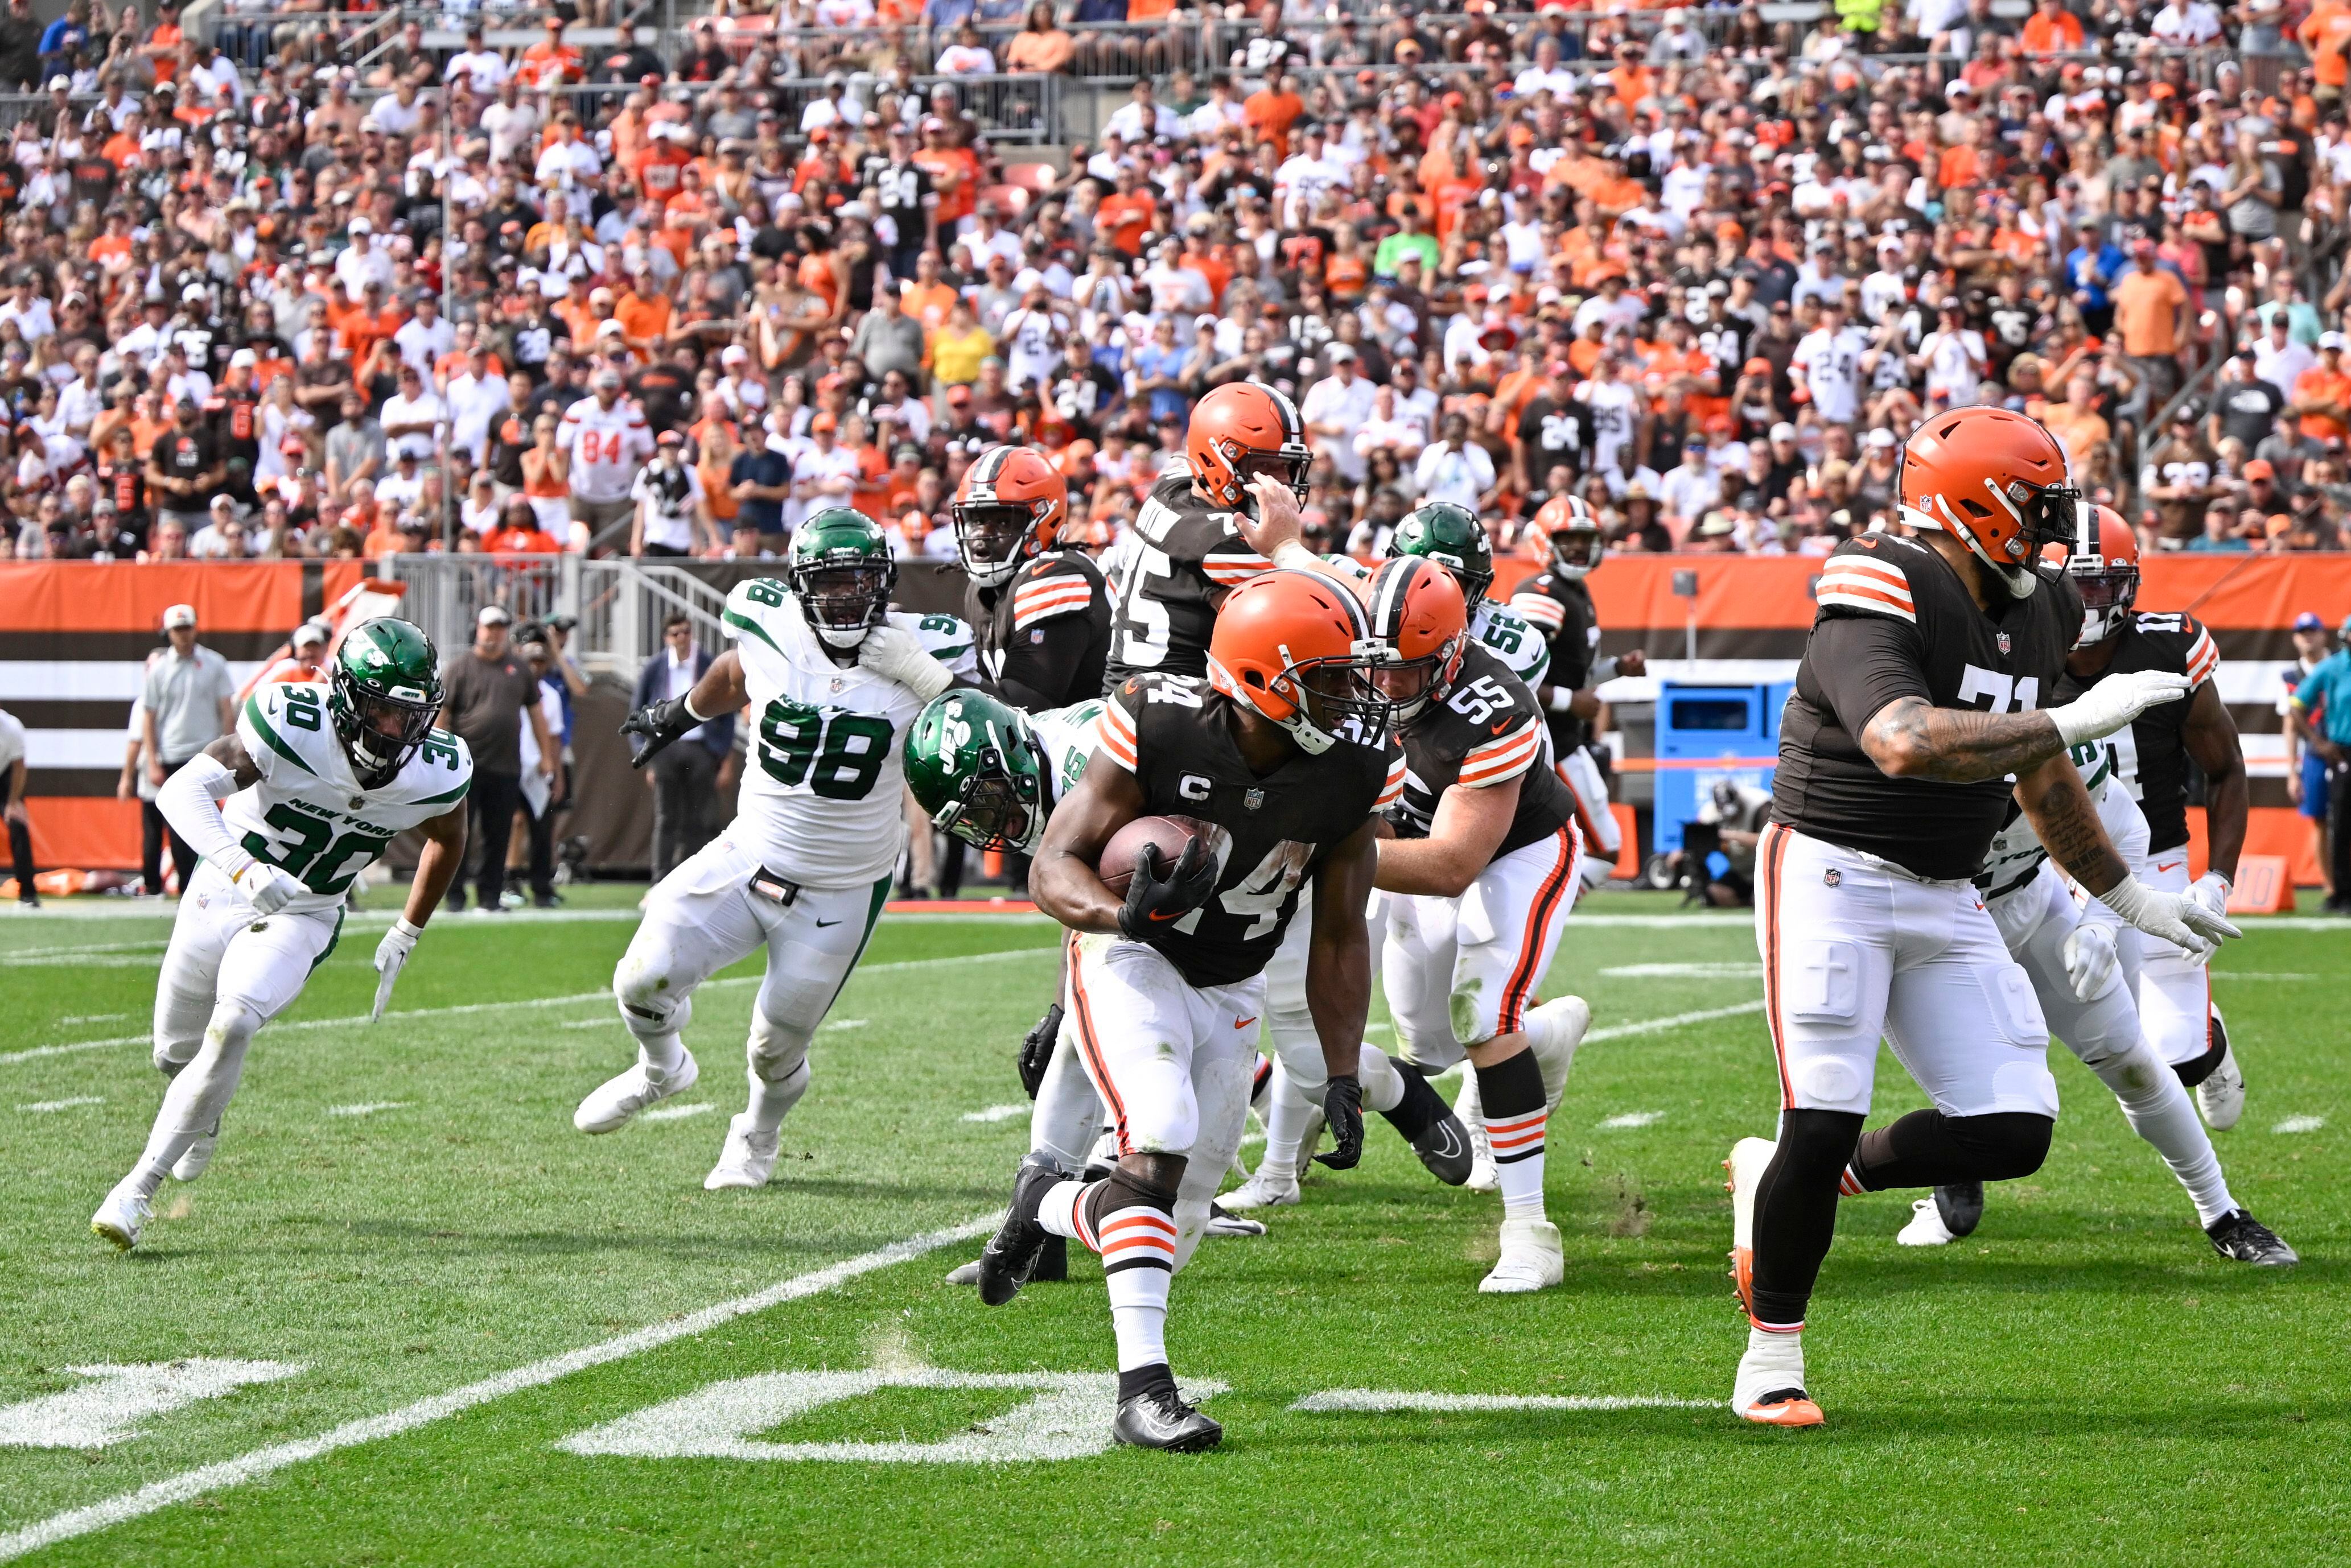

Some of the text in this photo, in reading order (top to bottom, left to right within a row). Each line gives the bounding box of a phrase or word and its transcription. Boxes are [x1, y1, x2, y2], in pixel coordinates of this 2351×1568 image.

[583, 430, 621, 465] 84
[1541, 415, 1579, 451] 24
[1482, 612, 1527, 655] 52
[2135, 612, 2182, 634] 11
[282, 684, 321, 732] 30
[1447, 675, 1516, 725] 55
[758, 699, 895, 800] 98
[939, 701, 962, 775] JETS
[1179, 774, 1212, 800] C
[288, 798, 343, 819] NEW
[240, 803, 396, 895] 30
[2239, 866, 2274, 906] 10
